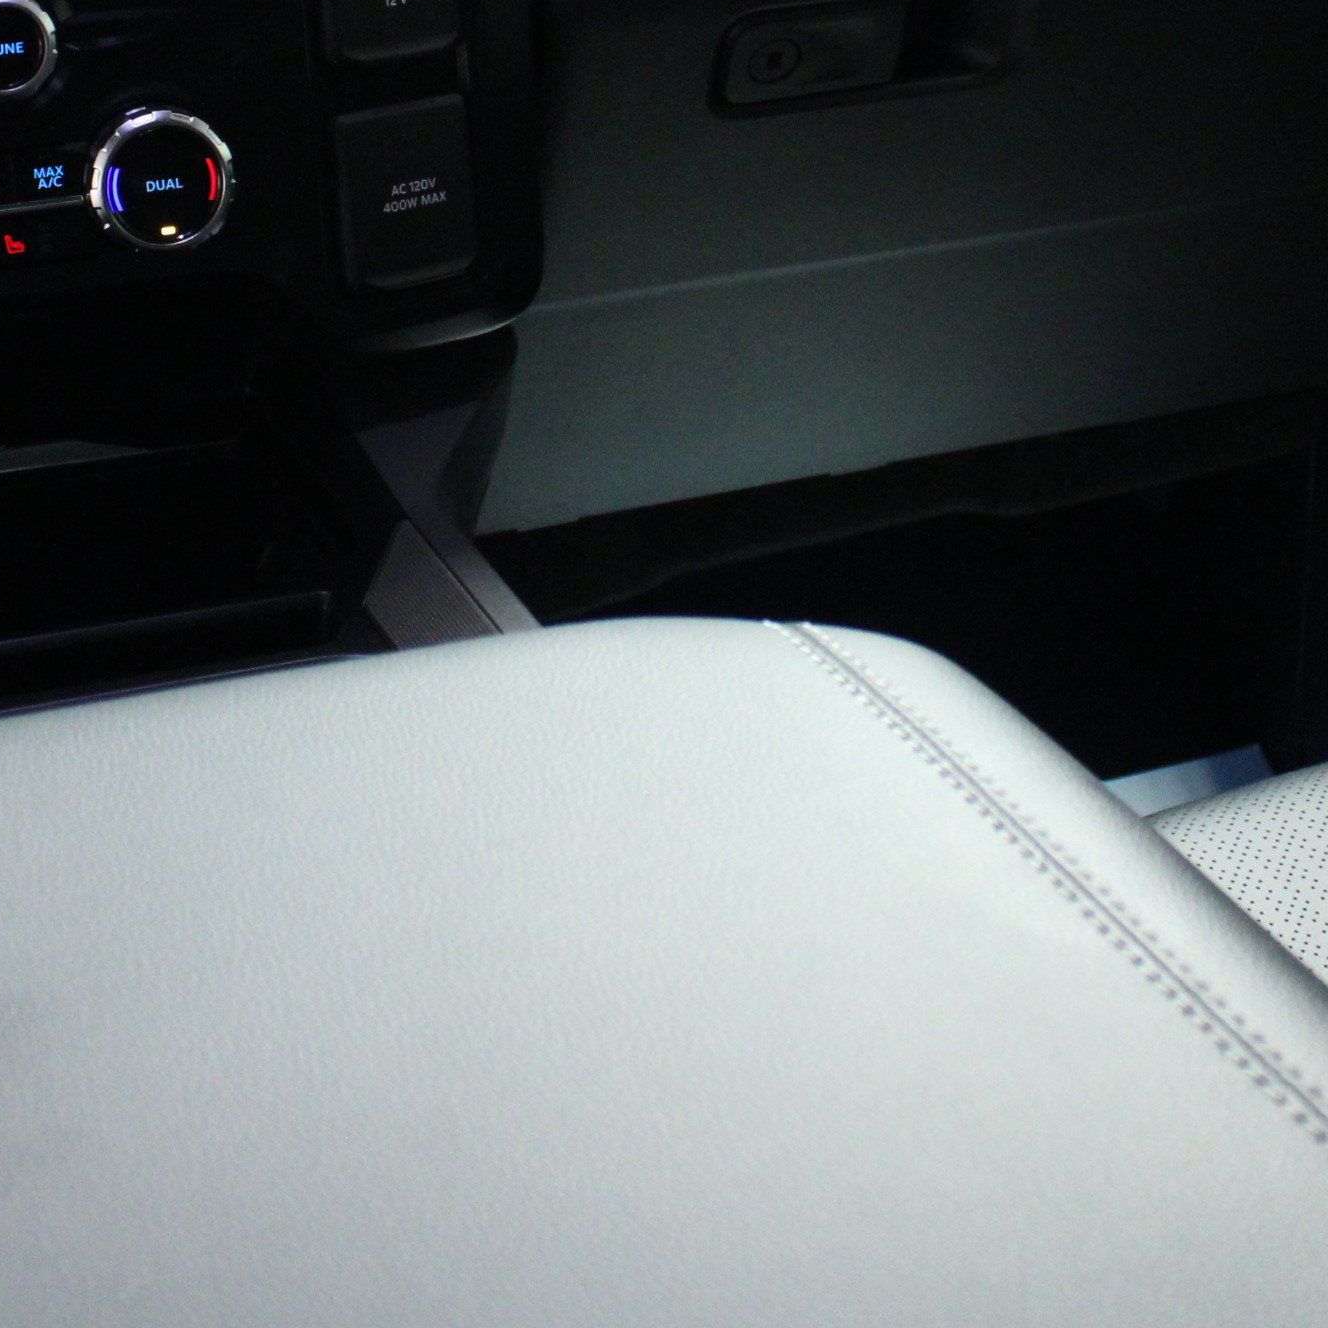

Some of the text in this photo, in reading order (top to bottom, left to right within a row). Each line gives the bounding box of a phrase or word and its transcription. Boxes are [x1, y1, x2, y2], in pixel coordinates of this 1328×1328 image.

[33, 164, 65, 179] MAX
[38, 174, 65, 190] A/C
[145, 176, 184, 193] DUAL
[391, 176, 437, 198] AC 120V
[383, 189, 448, 215] 400W MAX
